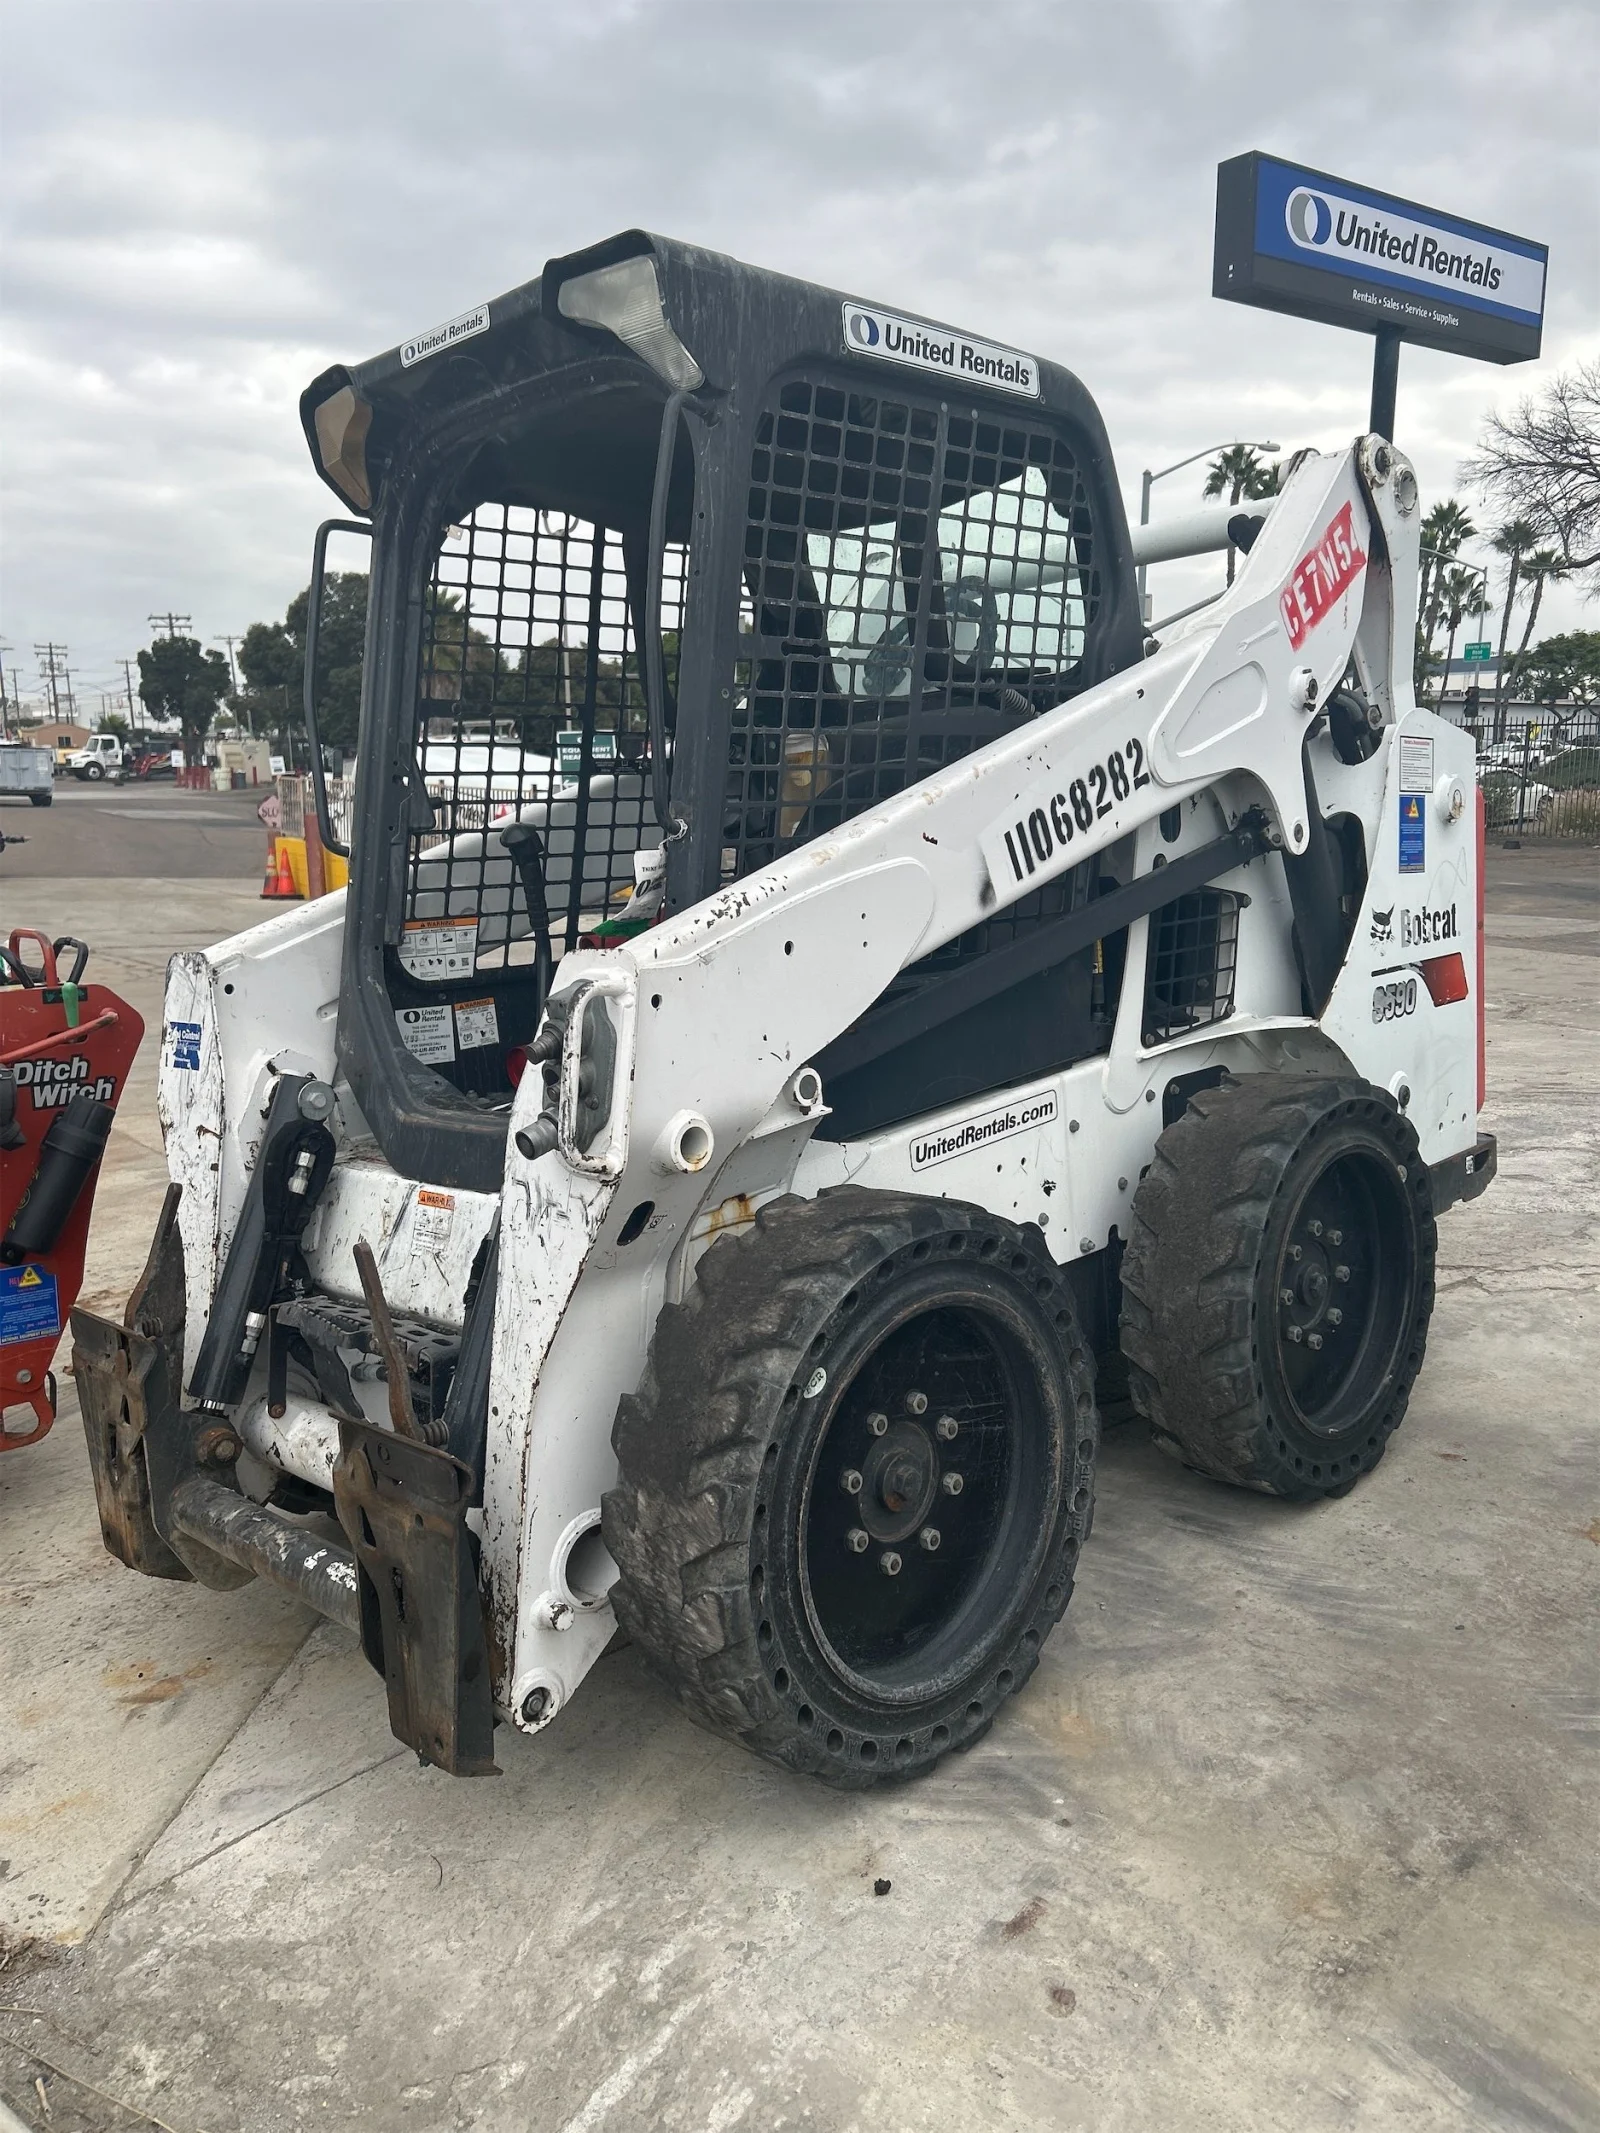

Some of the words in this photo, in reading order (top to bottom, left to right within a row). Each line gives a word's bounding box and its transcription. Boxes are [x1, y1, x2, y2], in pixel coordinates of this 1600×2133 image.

[1335, 210, 1421, 265] United
[1418, 235, 1501, 290] Rentals
[1352, 289, 1378, 305] Rentals
[1383, 296, 1400, 311] Sales
[1404, 302, 1428, 318] Service
[1432, 310, 1459, 327] Supplies
[417, 328, 447, 354] United
[449, 314, 483, 339] Rentals
[885, 323, 955, 366] United
[960, 344, 1030, 387] Rentals
[562, 746, 611, 754] EQUENT
[261, 806, 281, 818] SLO
[1003, 737, 1150, 882] 11068282
[1400, 903, 1457, 948] Bobcat
[421, 1008, 444, 1016] United
[14, 1056, 88, 1085] Ditch
[33, 1078, 113, 1108] Witch
[915, 1101, 1053, 1163] UnitedRentals.com
